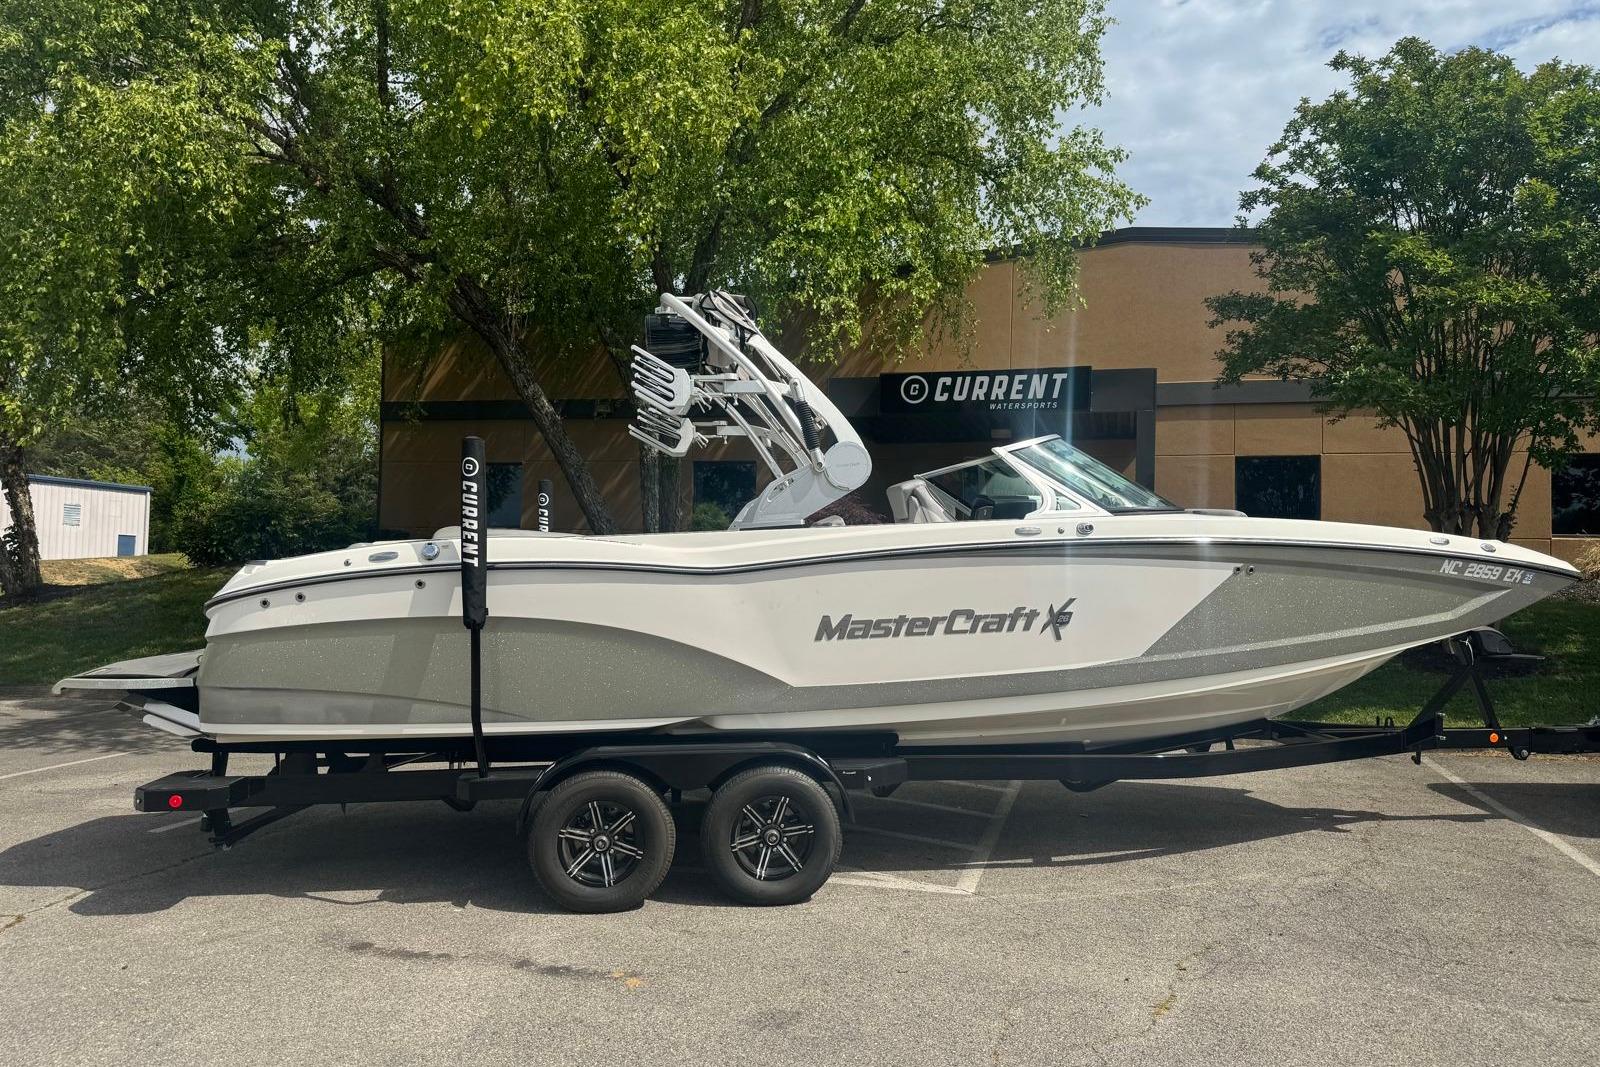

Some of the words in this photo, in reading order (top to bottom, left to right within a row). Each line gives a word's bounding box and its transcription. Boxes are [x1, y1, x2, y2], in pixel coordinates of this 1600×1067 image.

[934, 373, 1067, 402] CURRENT
[989, 401, 1058, 410] WATERSPORTS
[462, 480, 479, 567] CURRENT
[1439, 559, 1462, 575] NC
[1464, 563, 1503, 580] 2859
[814, 606, 1040, 642] MasterCraft
